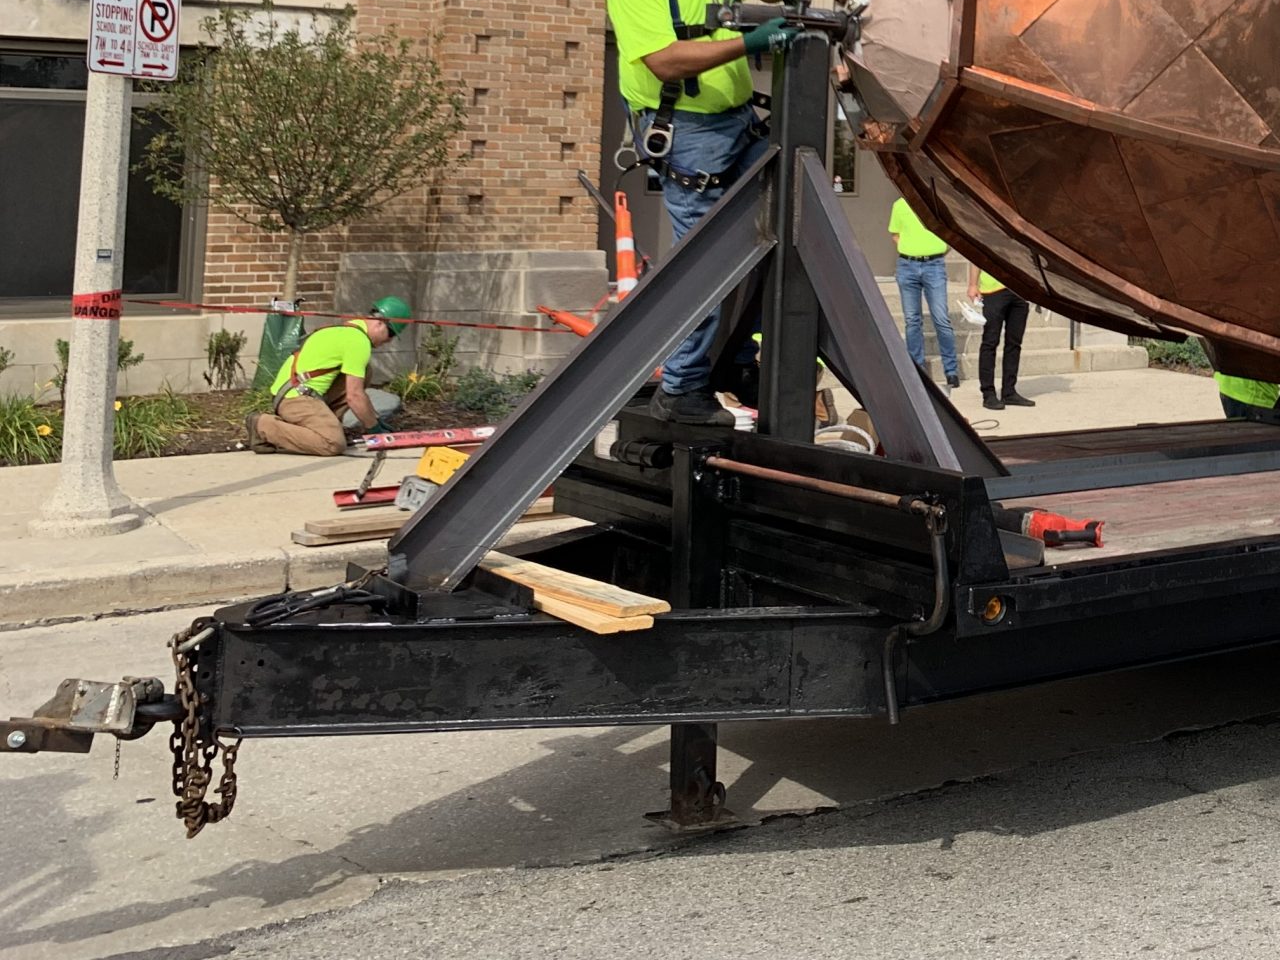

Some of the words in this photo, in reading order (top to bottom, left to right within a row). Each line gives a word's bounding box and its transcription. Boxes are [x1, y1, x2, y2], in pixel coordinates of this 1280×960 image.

[95, 3, 134, 22] STOPPING
[96, 21, 117, 34] SCHOOL
[119, 23, 132, 35] DAYS
[137, 41, 159, 52] SCHOOL
[161, 43, 175, 54] DAYS
